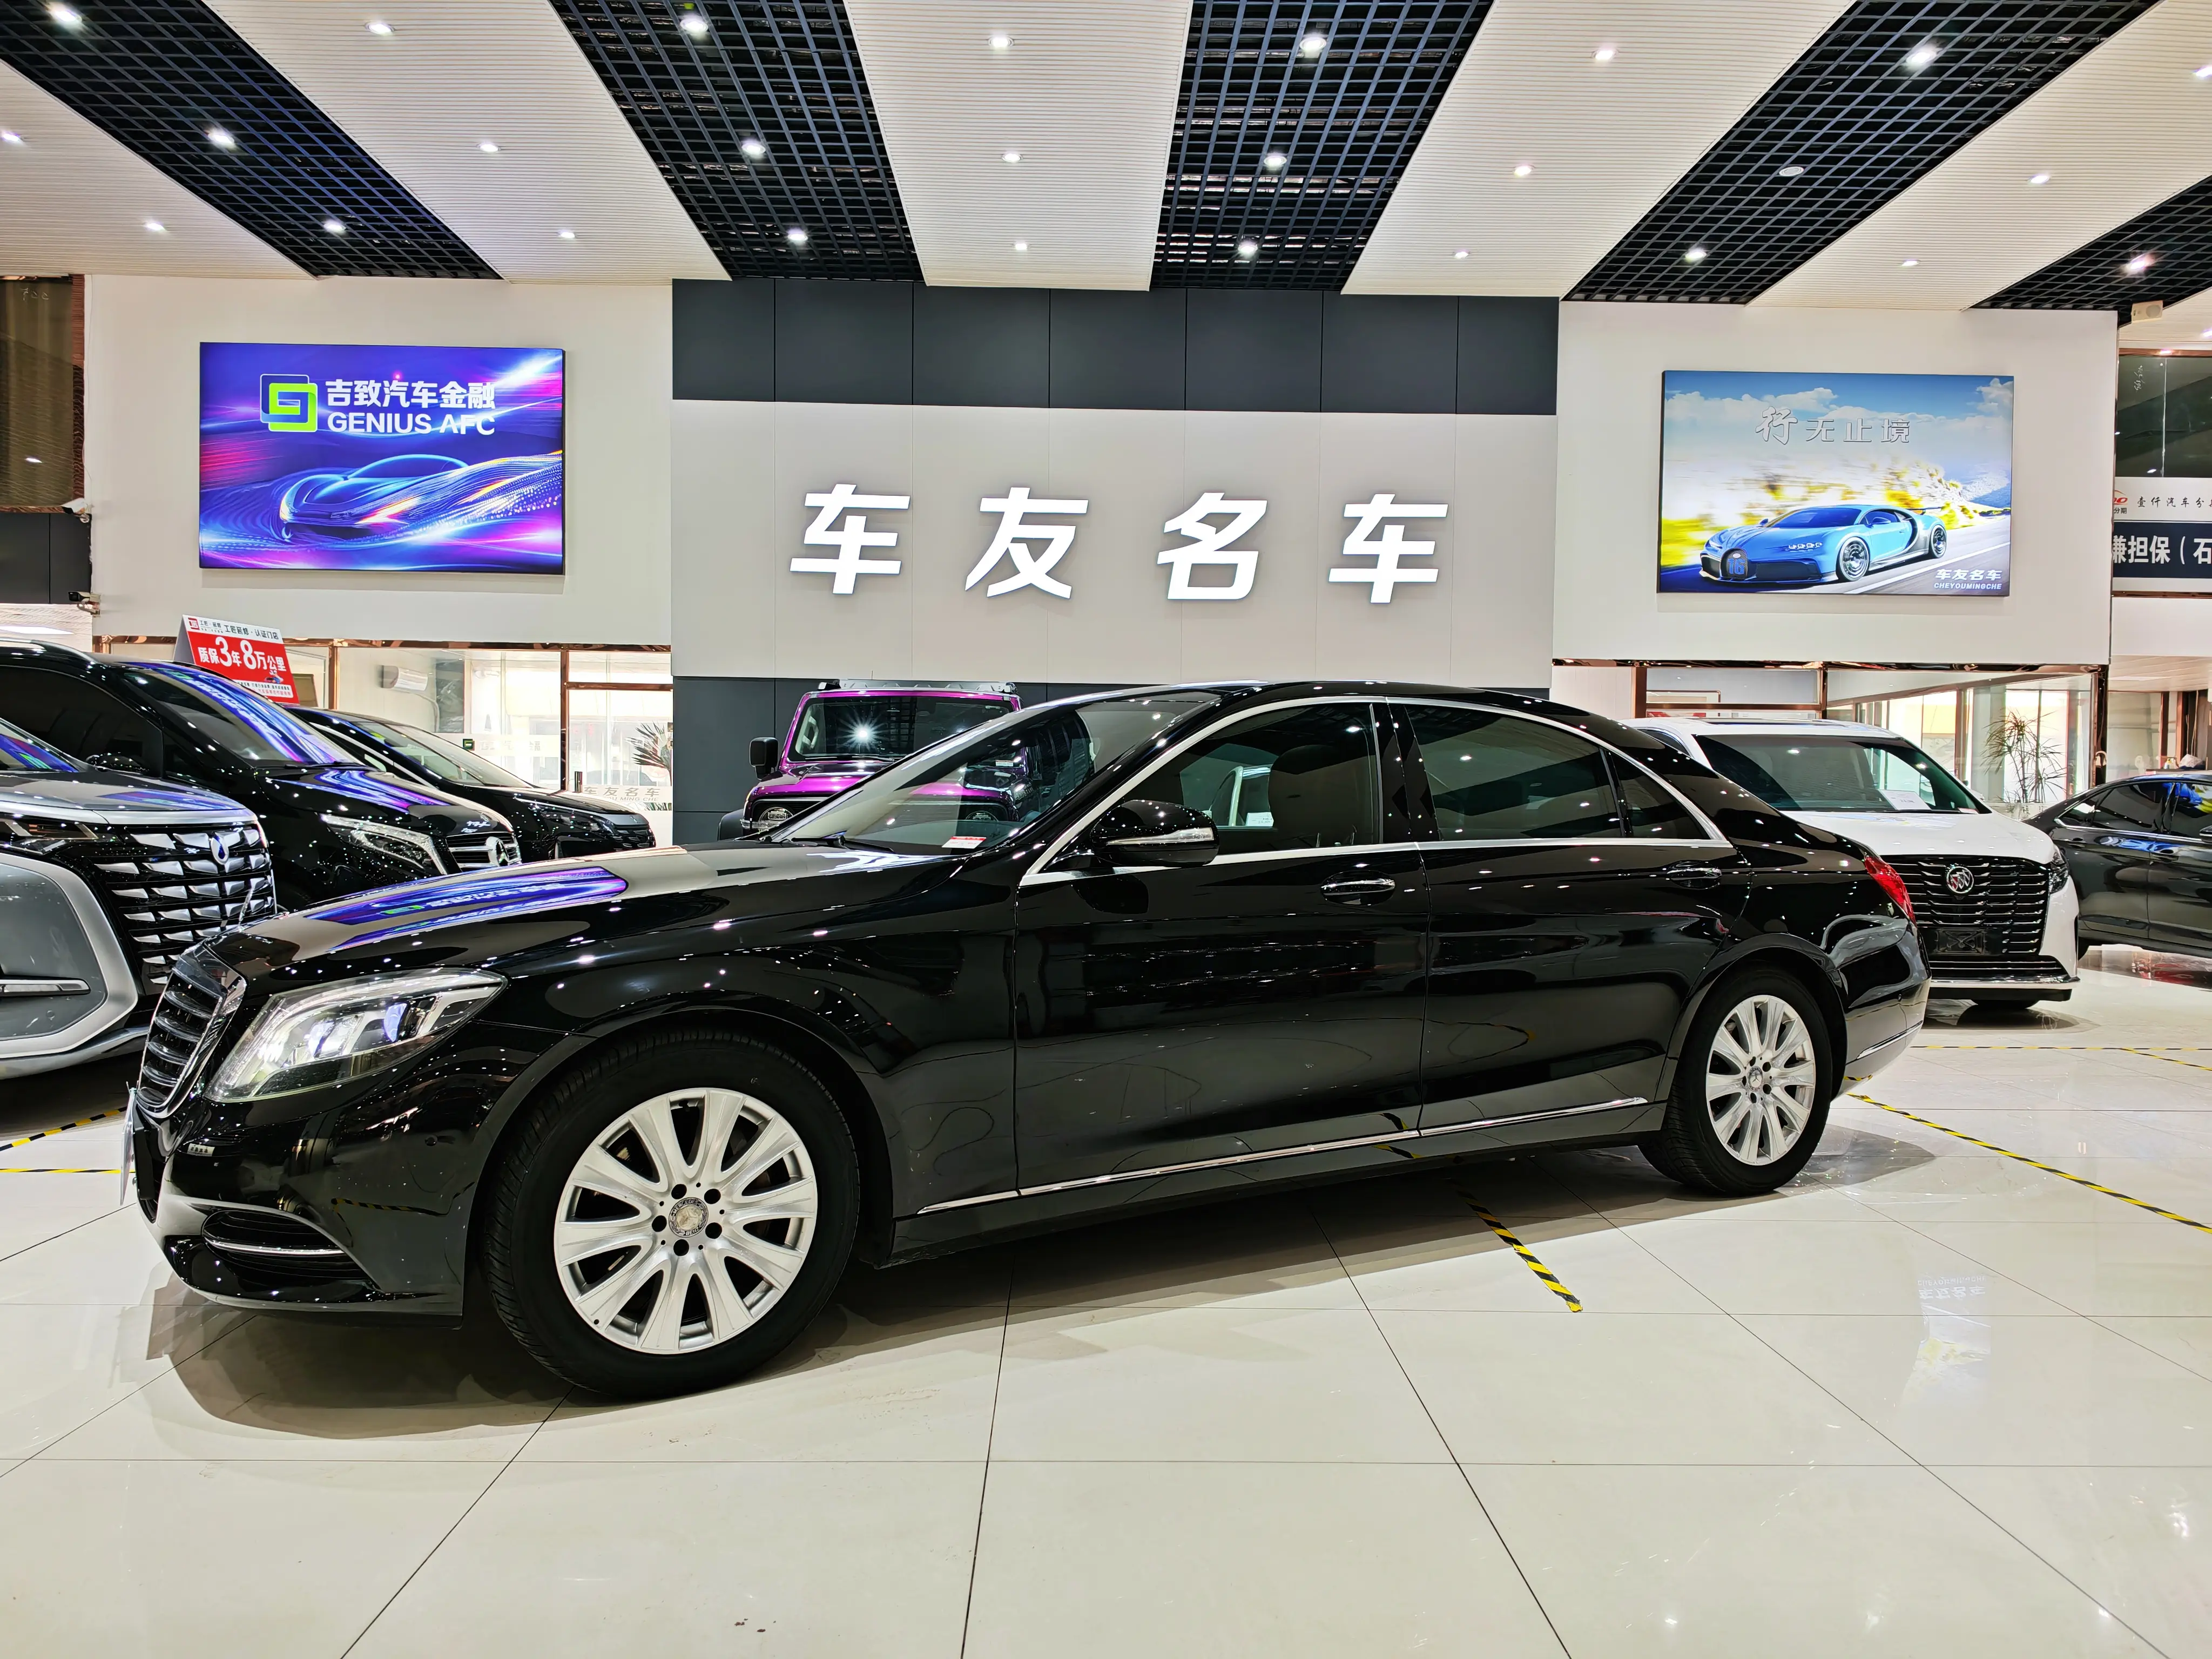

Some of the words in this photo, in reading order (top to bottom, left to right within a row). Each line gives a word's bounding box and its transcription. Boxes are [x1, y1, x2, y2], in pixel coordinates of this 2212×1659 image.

[325, 379, 496, 409] 吉致汽车金融
[327, 412, 431, 434] GENIUS
[440, 415, 495, 435] AFC
[1755, 406, 1911, 445] 行无止境
[790, 484, 1449, 604] 车友名车
[1935, 569, 2002, 581] 车友名车
[197, 636, 287, 672] 质保3年8万公里
[584, 786, 660, 797] 车友名车
[673, 1199, 699, 1214] MERCEDES
[685, 1226, 700, 1236] BENZ
